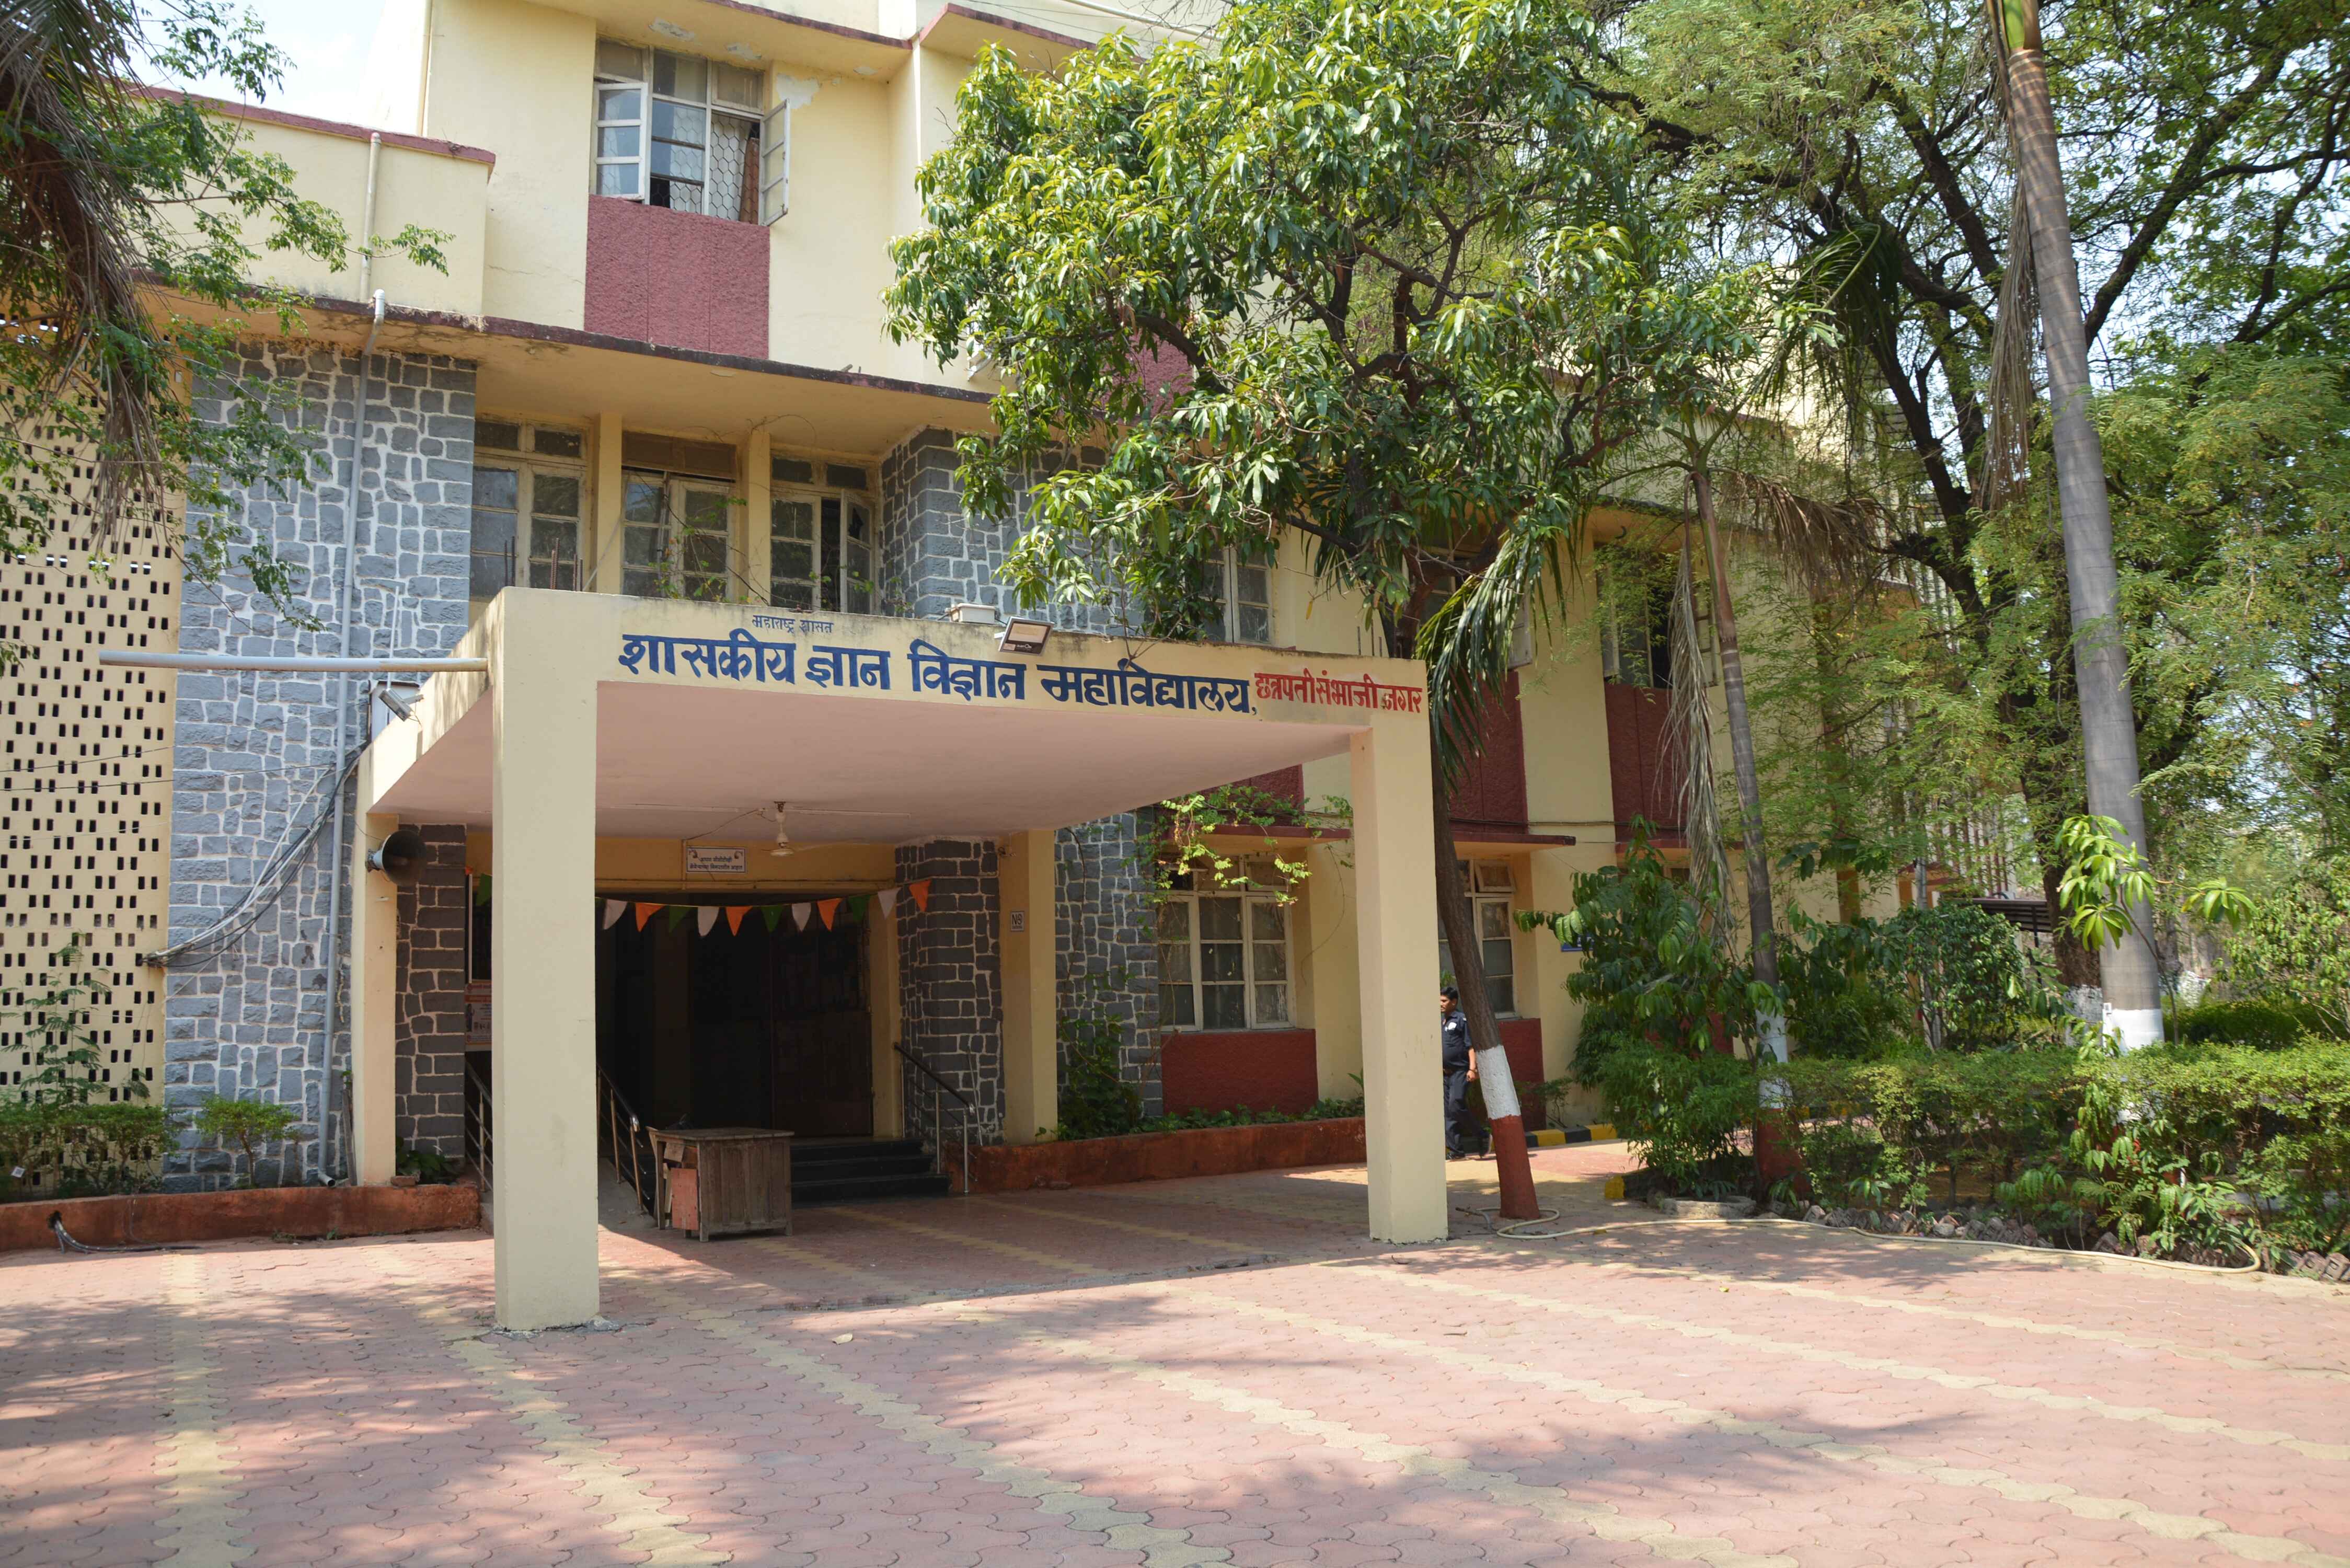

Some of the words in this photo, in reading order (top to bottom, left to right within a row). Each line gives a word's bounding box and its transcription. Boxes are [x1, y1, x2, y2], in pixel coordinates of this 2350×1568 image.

[752, 615, 796, 634] महाराष्ट्र
[618, 628, 797, 684] शासकीय
[805, 645, 891, 690] ज्ञान
[907, 638, 1027, 701] विज्ञान
